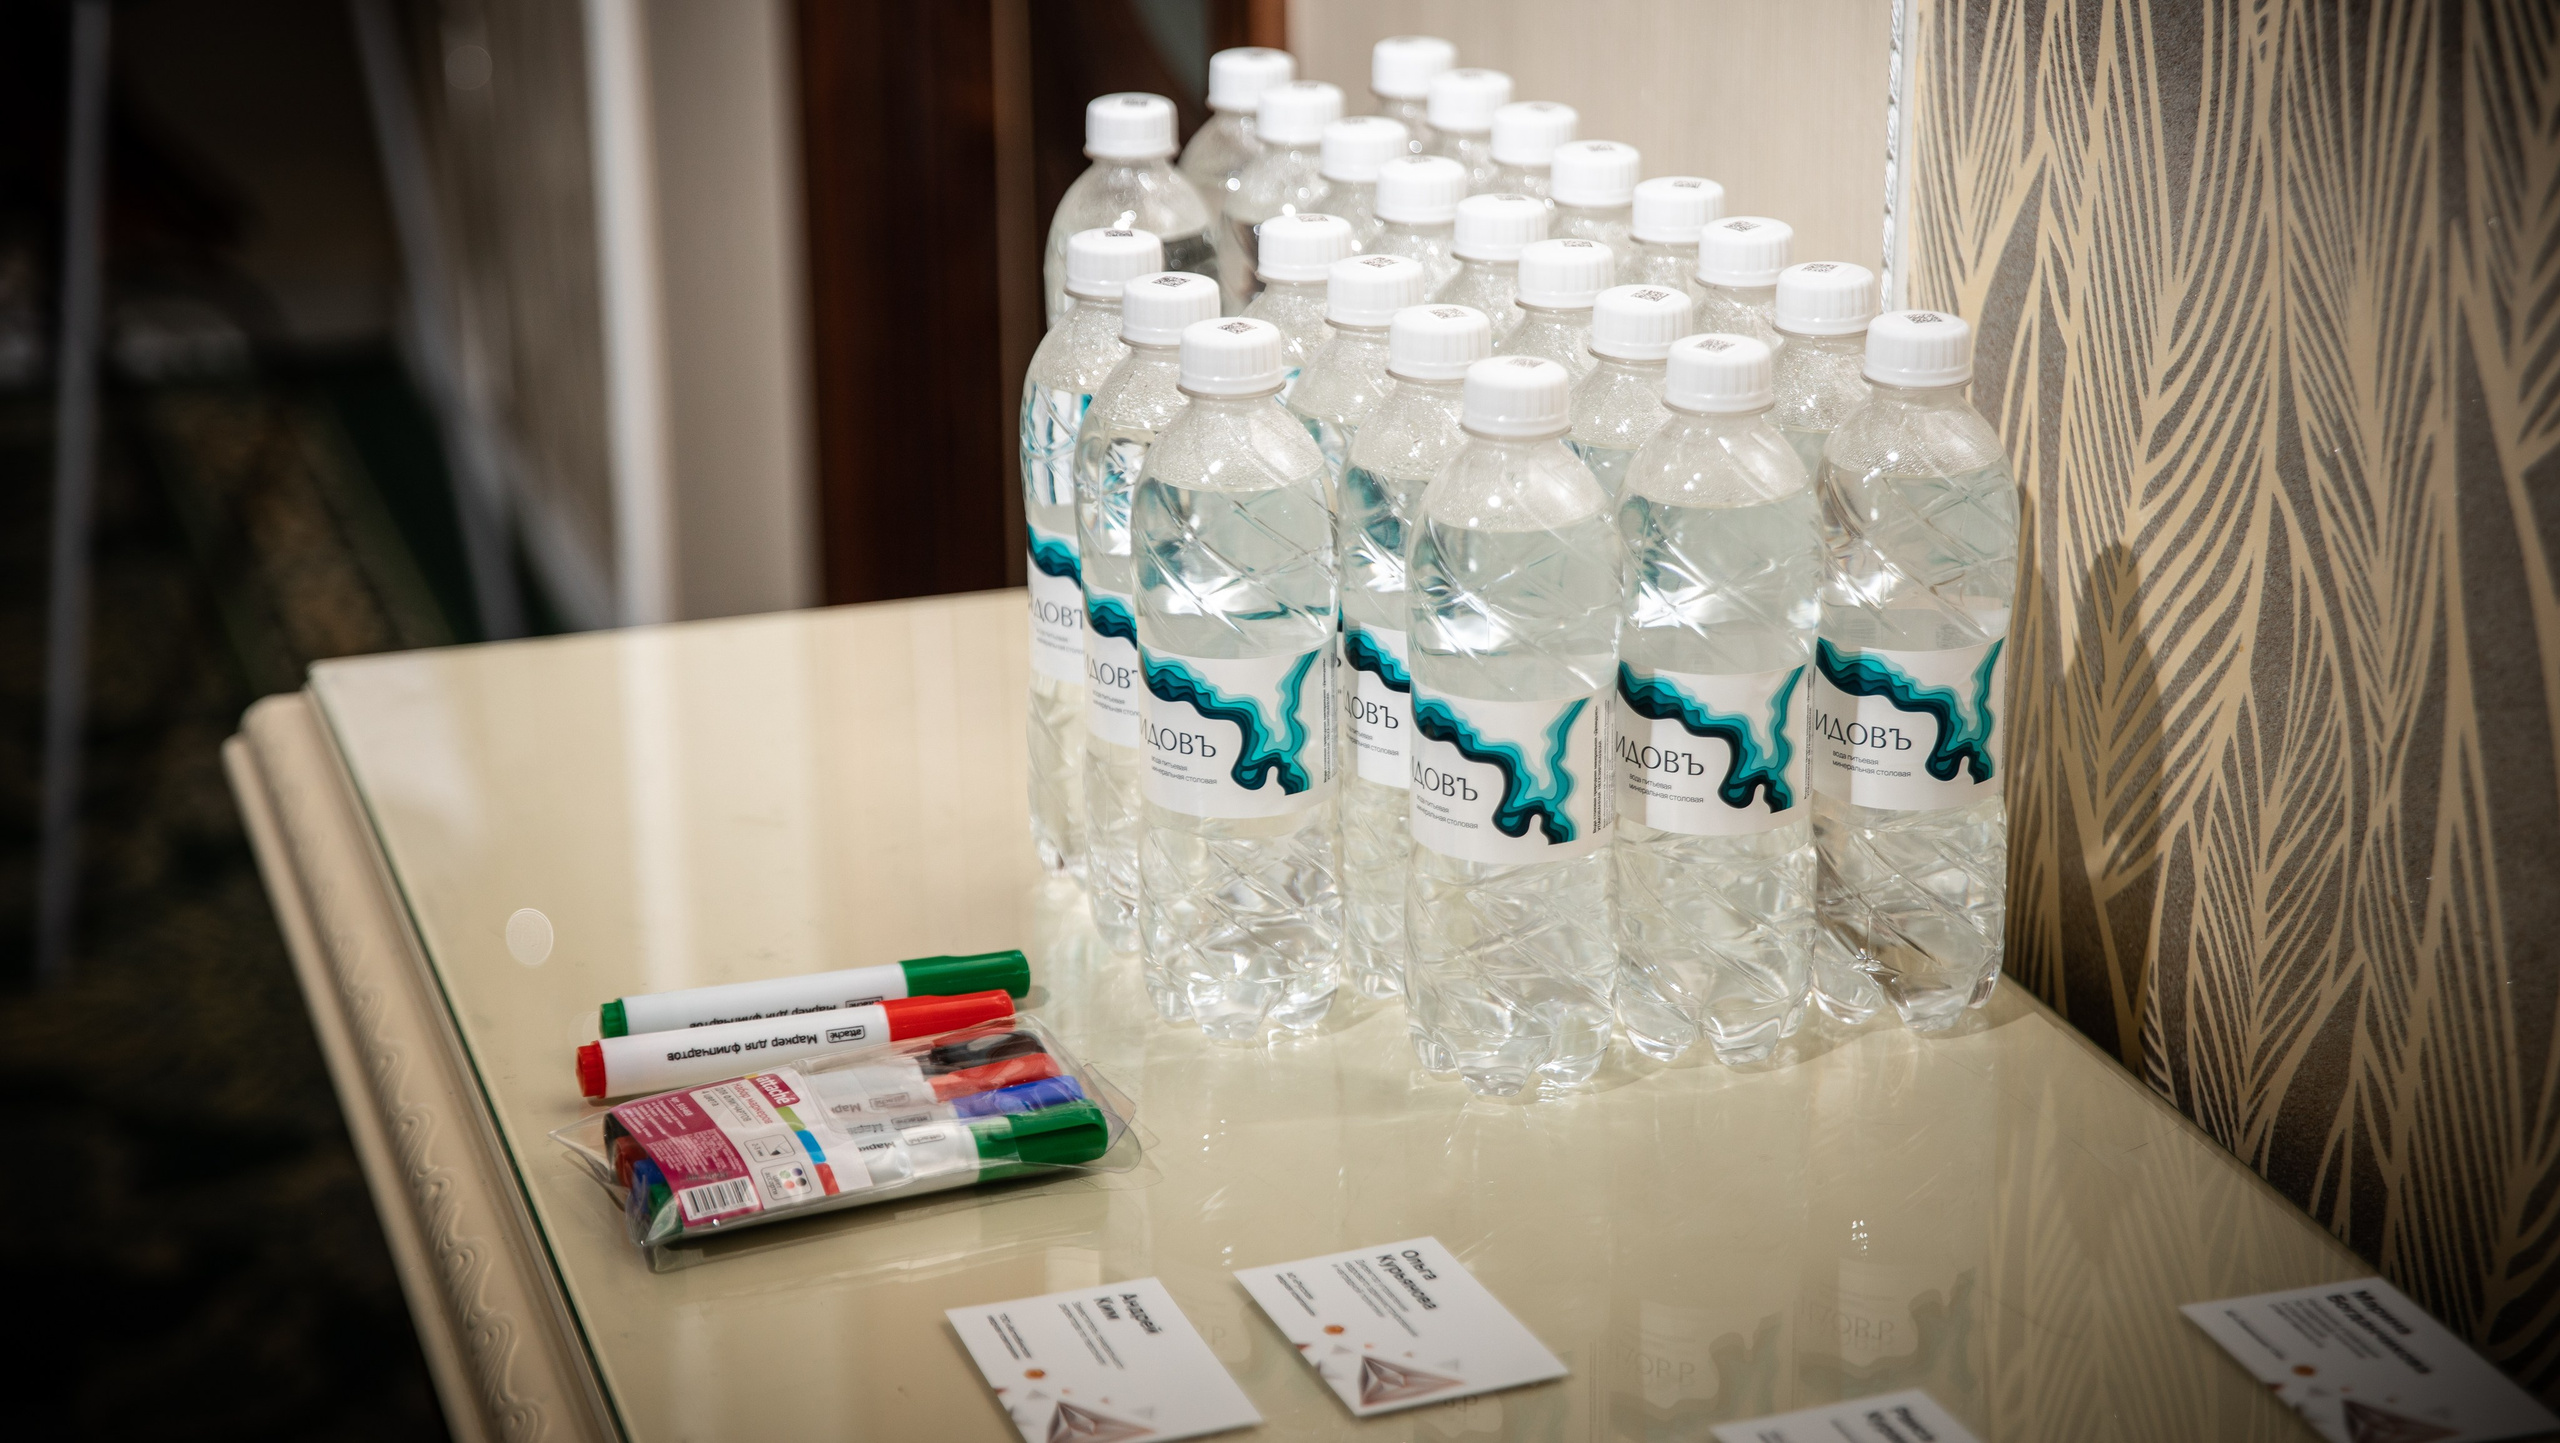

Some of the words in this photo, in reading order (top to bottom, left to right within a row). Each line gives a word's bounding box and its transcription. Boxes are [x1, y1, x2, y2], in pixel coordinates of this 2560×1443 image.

[1085, 653, 1139, 690] ДОВ
[1815, 709, 1912, 751] ИДОВЪ
[1832, 750, 1847, 760] вода
[1846, 753, 1879, 766] питьевая
[1832, 760, 1876, 776] минеральная
[1875, 769, 1912, 778] столовая
[1185, 775, 1218, 785] столовая
[1641, 778, 1673, 790] питьевая
[1628, 783, 1669, 800] минеральная
[1668, 794, 1704, 804] столовая
[1446, 817, 1479, 830] столовая
[771, 1034, 818, 1047] Маркер
[829, 1028, 862, 1041] attaché
[667, 1042, 741, 1061] флипчартов
[744, 1039, 768, 1051] для
[756, 1076, 796, 1105] attaché
[1401, 1249, 1438, 1281] Ольга
[1375, 1253, 1438, 1311] Курьянова
[1093, 1297, 1120, 1321] Ким
[1118, 1293, 1163, 1334] Андрей
